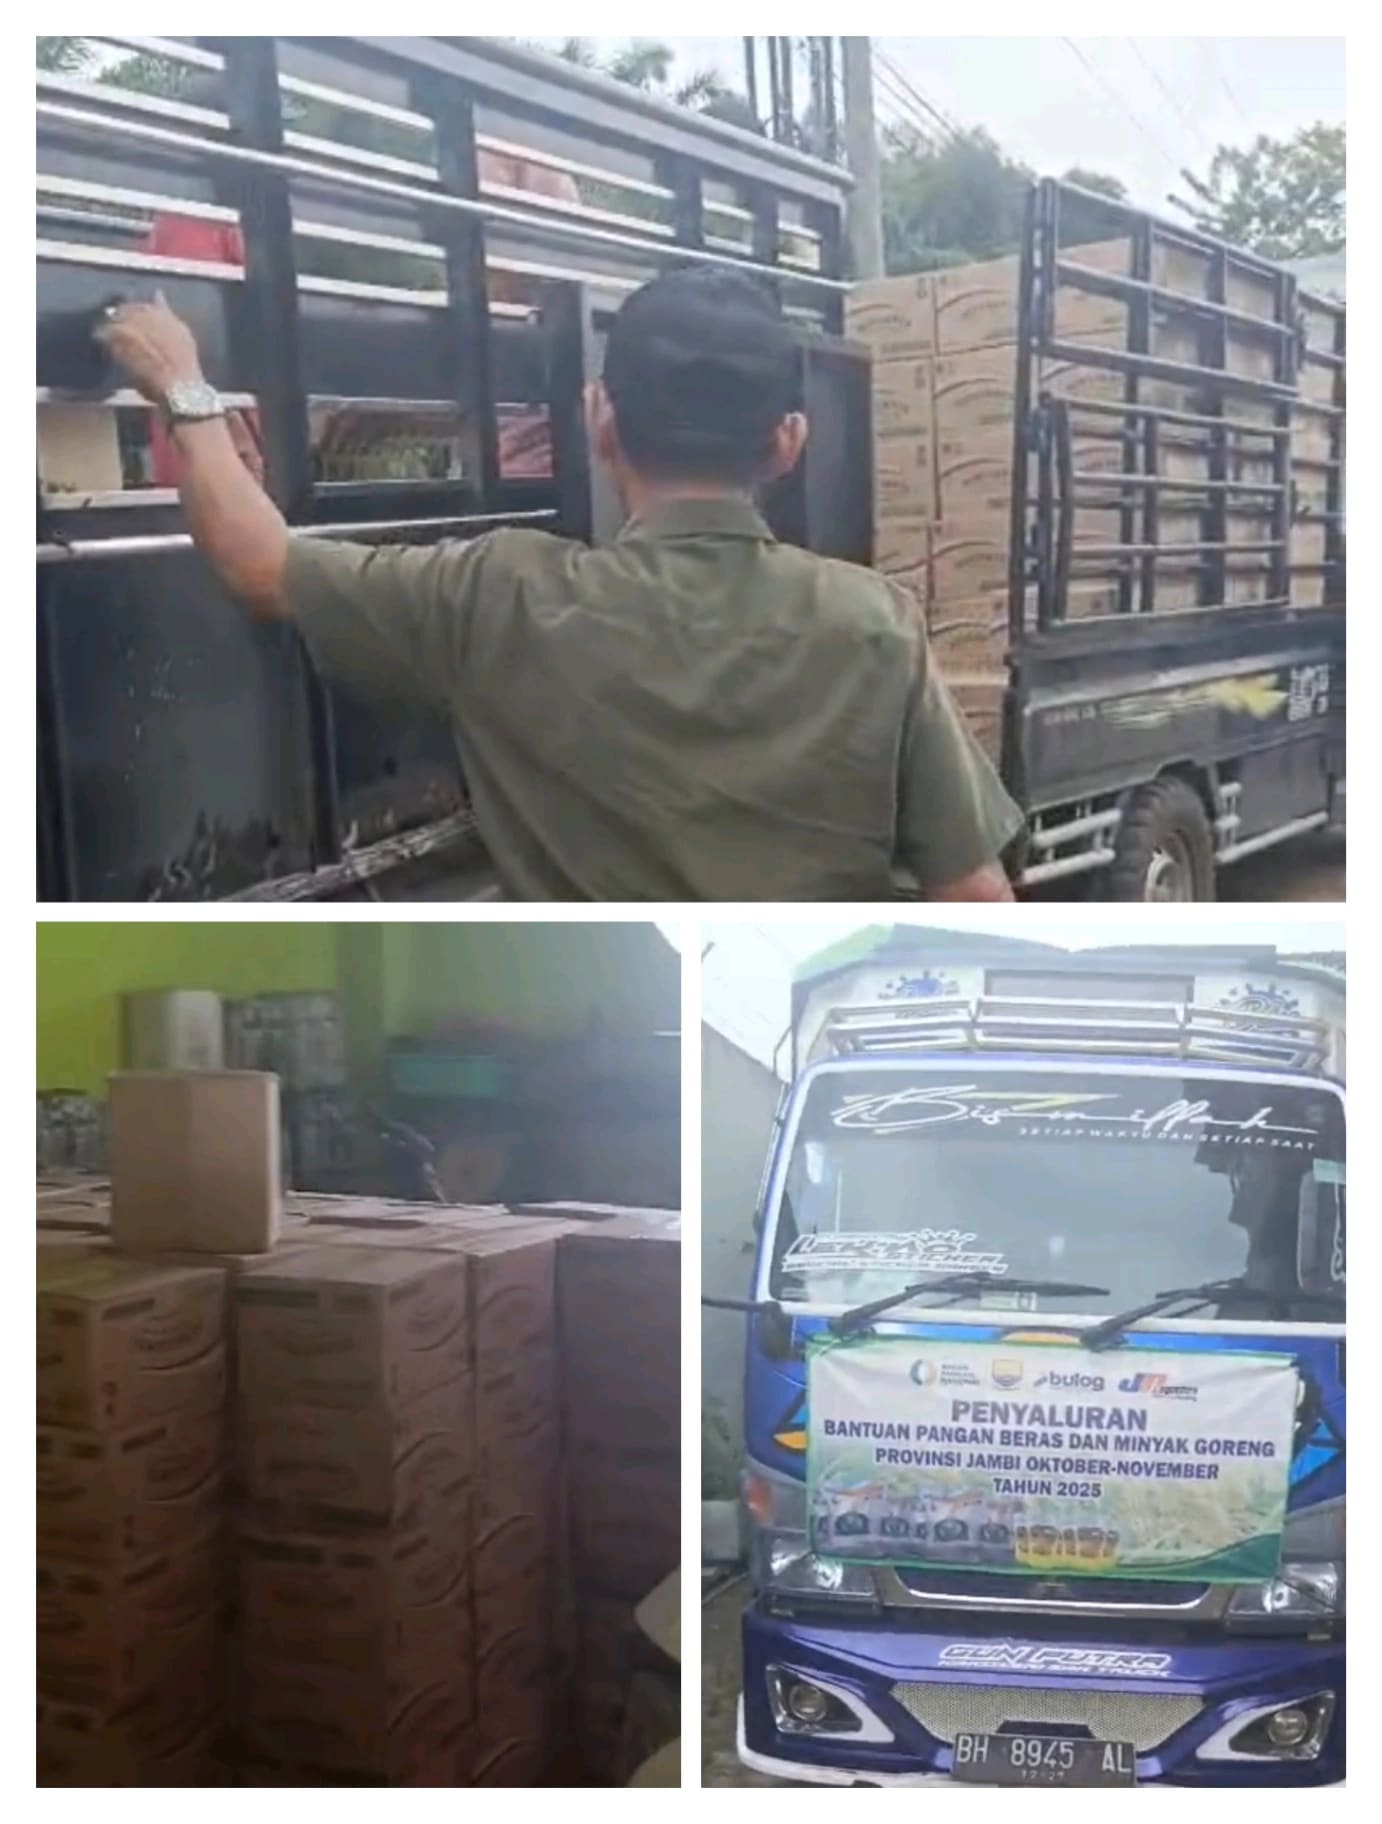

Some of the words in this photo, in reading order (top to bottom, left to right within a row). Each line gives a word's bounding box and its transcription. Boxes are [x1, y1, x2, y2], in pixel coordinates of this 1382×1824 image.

[1157, 1131, 1194, 1141] DAN
[1199, 1133, 1265, 1145] SETIAP
[1270, 1137, 1316, 1151] SAAT
[1049, 1371, 1106, 1392] bulog
[951, 1399, 1148, 1431] PENYALURAN
[824, 1419, 911, 1440] BANTUAN
[916, 1425, 994, 1445] PANGAN
[1000, 1430, 1063, 1449] BERAS
[1069, 1433, 1108, 1451] DAN
[1114, 1435, 1189, 1454] MINYAK
[1194, 1439, 1275, 1457] GORENG
[875, 1448, 961, 1467] PROVINSI
[967, 1454, 1021, 1471] JAMBI
[1026, 1456, 1219, 1480] OKTOBER-NOVEMBER
[993, 1478, 1052, 1495] TAHUN
[1057, 1482, 1102, 1498] 2025
[938, 1643, 1033, 1665] GUN
[1029, 1648, 1172, 1670] PUTRA
[956, 1734, 990, 1764] BH
[1010, 1738, 1075, 1770] 8945
[1101, 1743, 1133, 1774] AL
